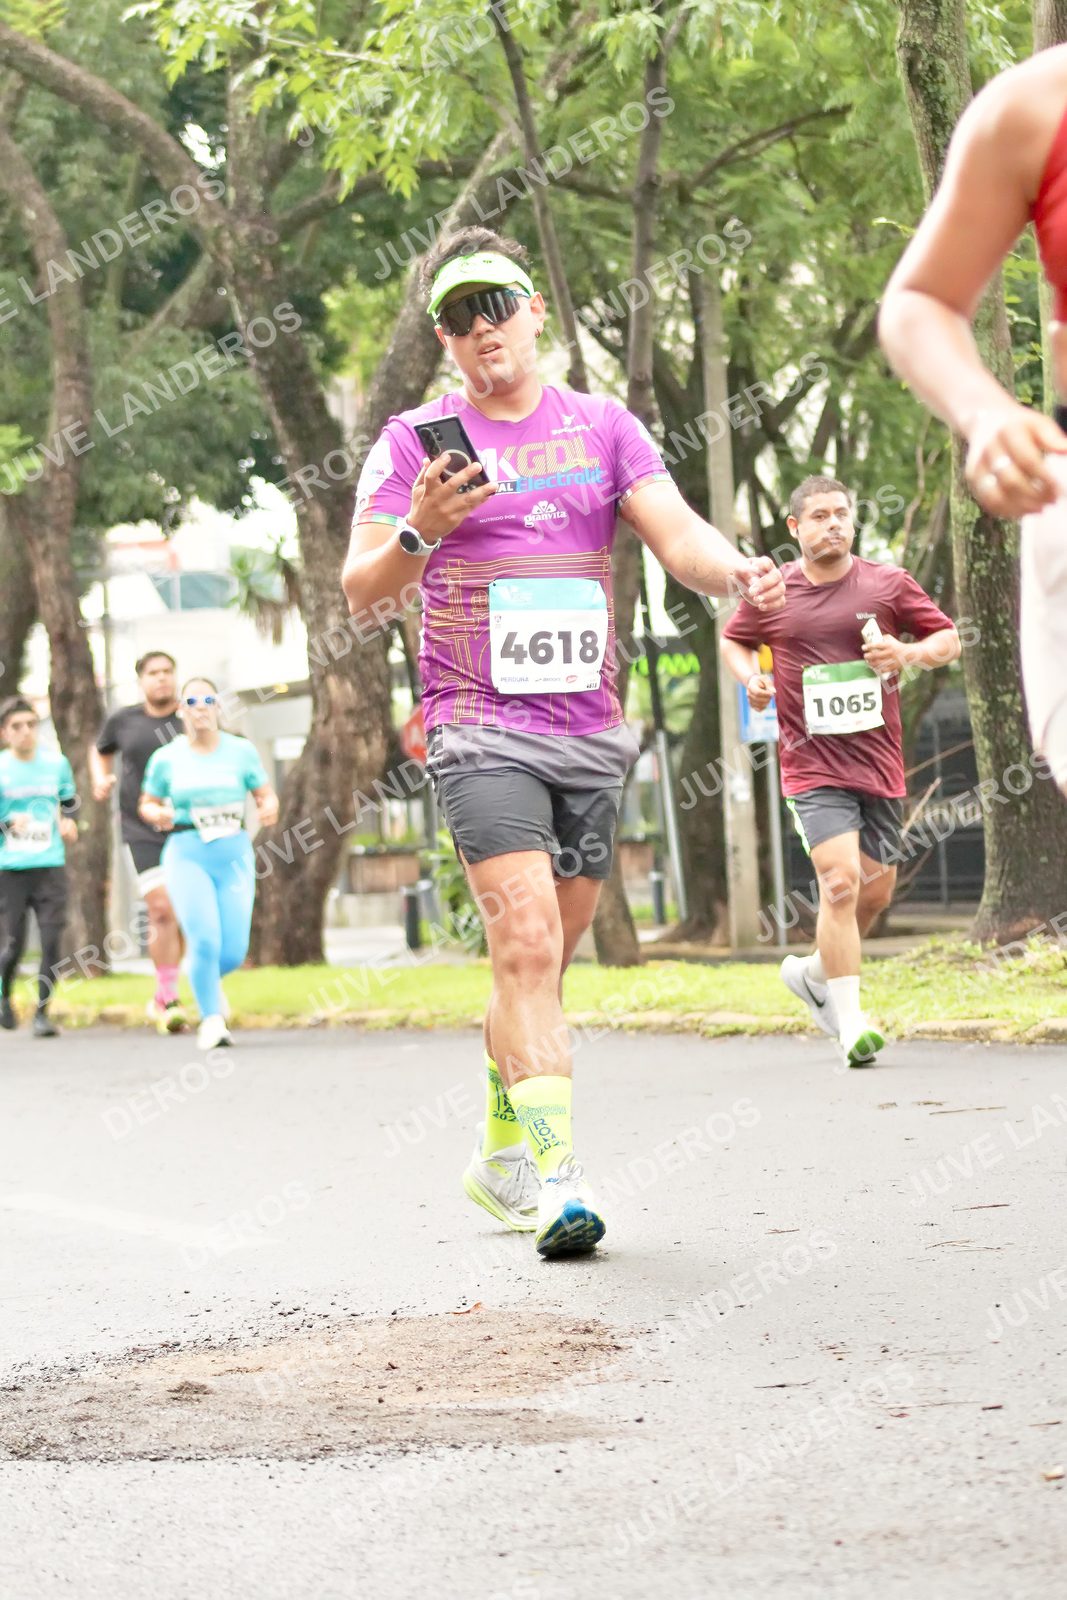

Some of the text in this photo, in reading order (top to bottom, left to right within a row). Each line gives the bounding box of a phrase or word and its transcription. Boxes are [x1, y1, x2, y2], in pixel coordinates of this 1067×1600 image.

[515, 467, 605, 493] Electrolit
[479, 515, 504, 524] NUTRIDO
[524, 511, 568, 528] granvita
[500, 629, 600, 665] 4618
[813, 691, 877, 717] 1065
